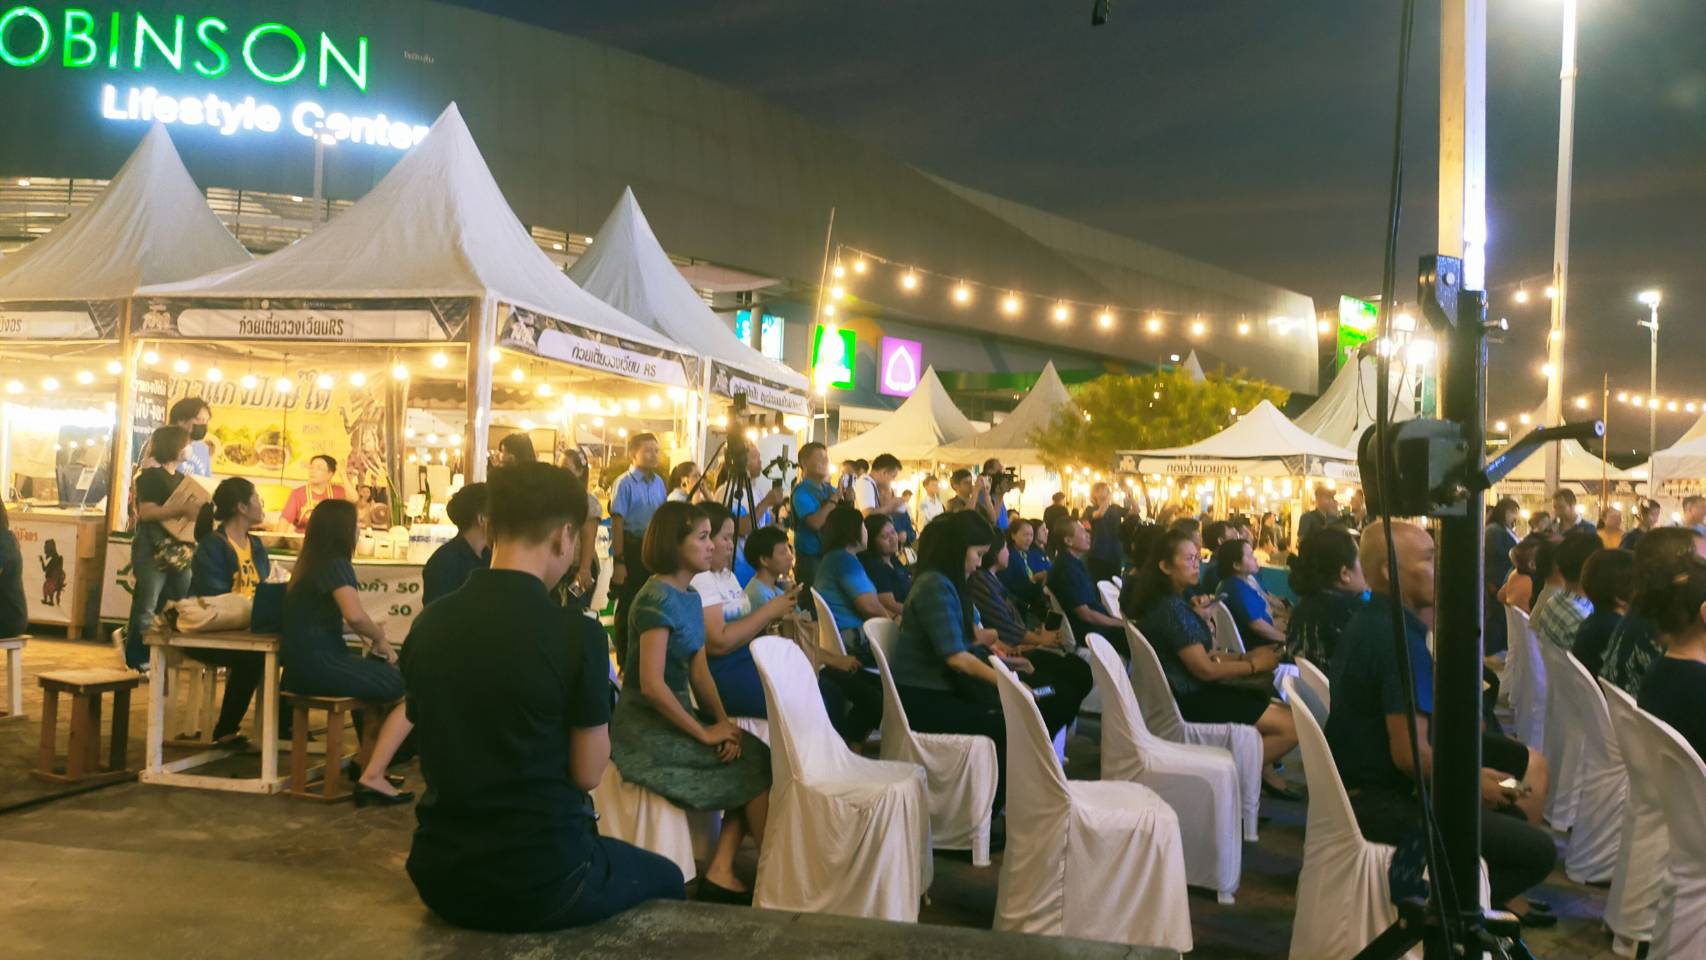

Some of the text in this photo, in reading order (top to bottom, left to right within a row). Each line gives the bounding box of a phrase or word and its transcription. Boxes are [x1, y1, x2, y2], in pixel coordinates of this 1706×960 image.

[103, 83, 430, 150] Lifestyle Center
[643, 363, 657, 377] RS
[396, 582, 420, 594] 50
[388, 604, 412, 616] 50
